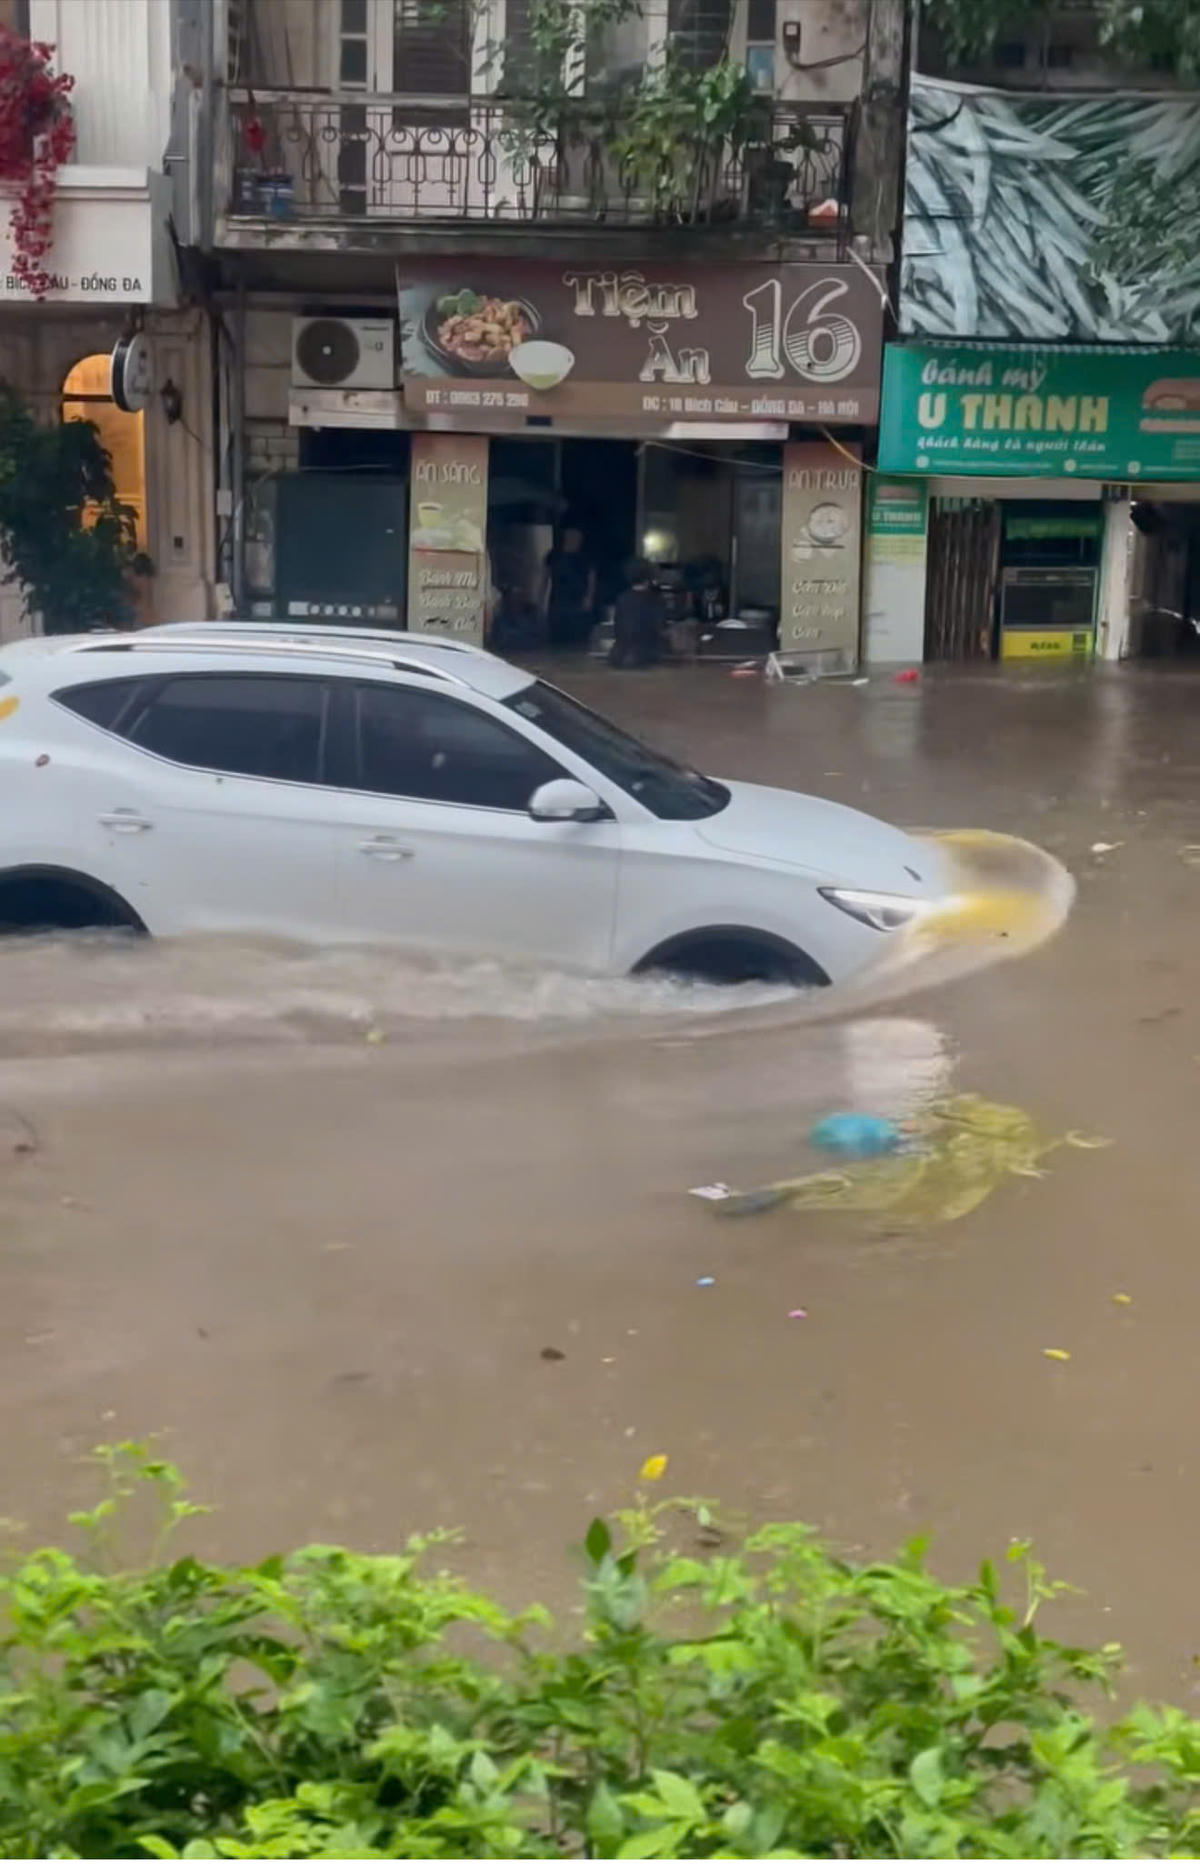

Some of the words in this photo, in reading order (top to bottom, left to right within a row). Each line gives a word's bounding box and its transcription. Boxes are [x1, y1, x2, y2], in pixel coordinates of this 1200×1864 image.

[562, 270, 698, 328] Tiệm
[639, 321, 712, 385] Ăn
[743, 277, 862, 383] 16
[921, 357, 992, 387] bánh
[917, 393, 947, 429] U
